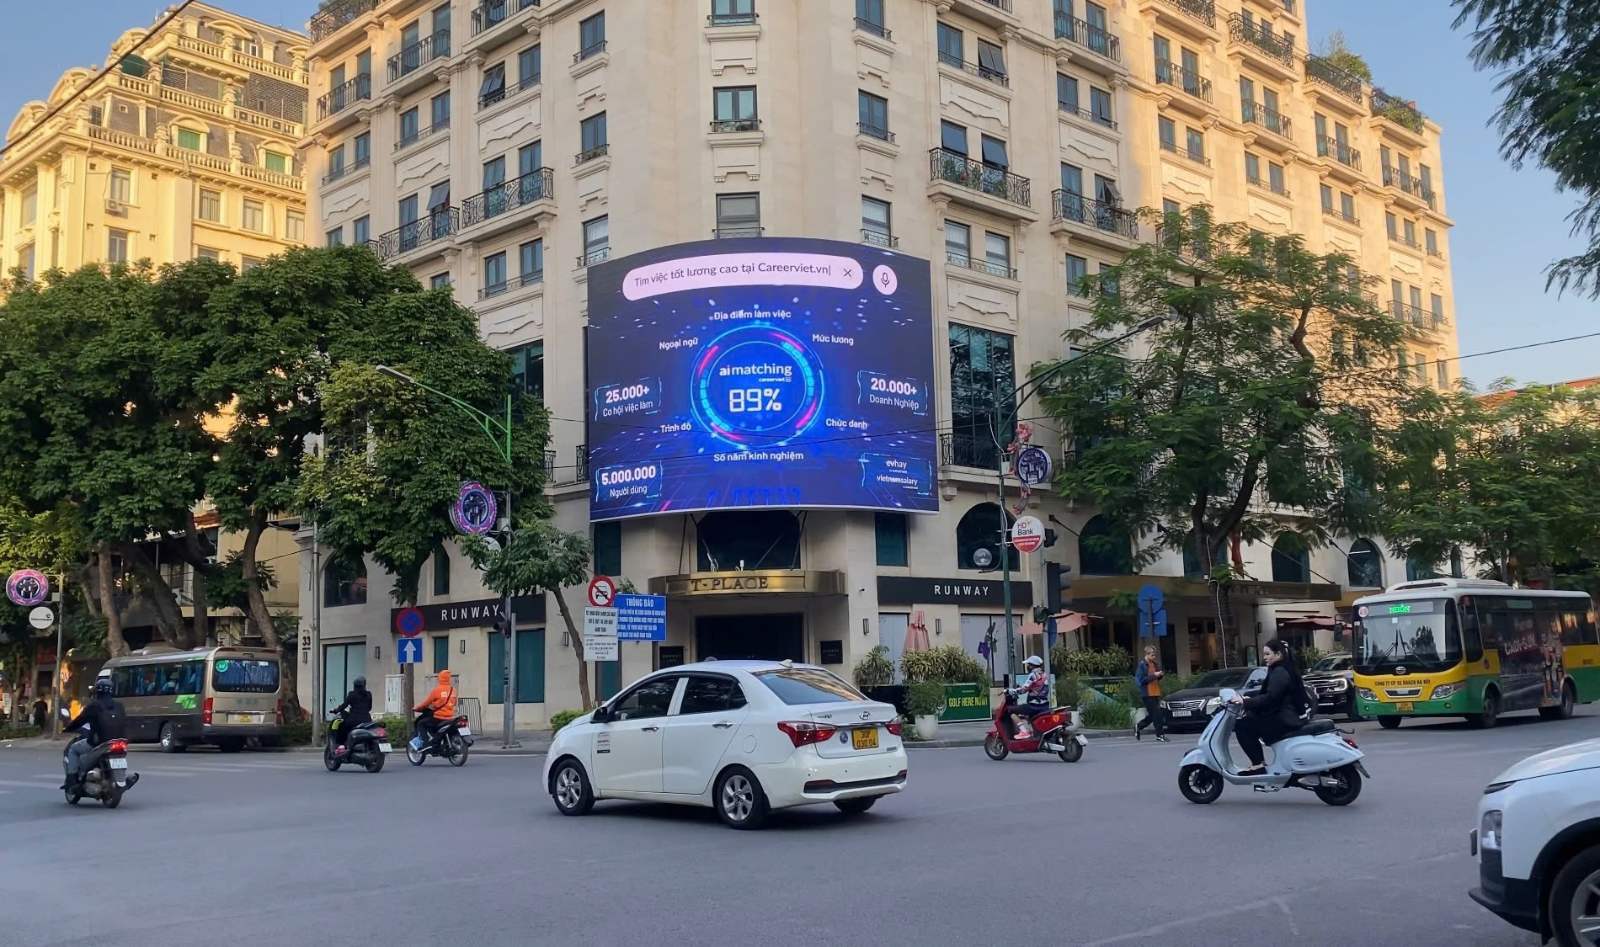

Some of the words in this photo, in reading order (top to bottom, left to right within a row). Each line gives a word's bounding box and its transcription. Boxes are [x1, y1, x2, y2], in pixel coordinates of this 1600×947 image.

[651, 272, 668, 284] việc
[671, 267, 684, 280] tốt
[687, 266, 717, 277] lương
[719, 265, 738, 273] cao
[742, 263, 755, 275] tại
[714, 311, 728, 321] Địa
[730, 309, 753, 319] điểm
[754, 309, 771, 319] làm
[772, 309, 791, 319] việc
[659, 338, 681, 350] Ngoại
[682, 337, 699, 348] ngữ
[812, 333, 830, 343] Mức
[870, 378, 917, 395] 20.000+
[605, 384, 650, 404] 25.000+
[729, 388, 782, 412] 89%
[869, 394, 893, 405] Doanh
[894, 398, 919, 410] Nghiệp
[613, 405, 624, 416] hội
[625, 403, 639, 413] việc
[826, 418, 847, 428] Chức
[848, 419, 868, 429] danh
[727, 451, 747, 461] năm
[749, 451, 768, 461] kinh
[770, 451, 804, 462] nghiệm
[602, 465, 656, 486] 5.000.000
[609, 486, 629, 499] Người
[935, 584, 989, 596] RUNWAY
[441, 603, 499, 621] RUNWAY
[948, 697, 961, 707] GOLF
[961, 696, 974, 706] HERE
